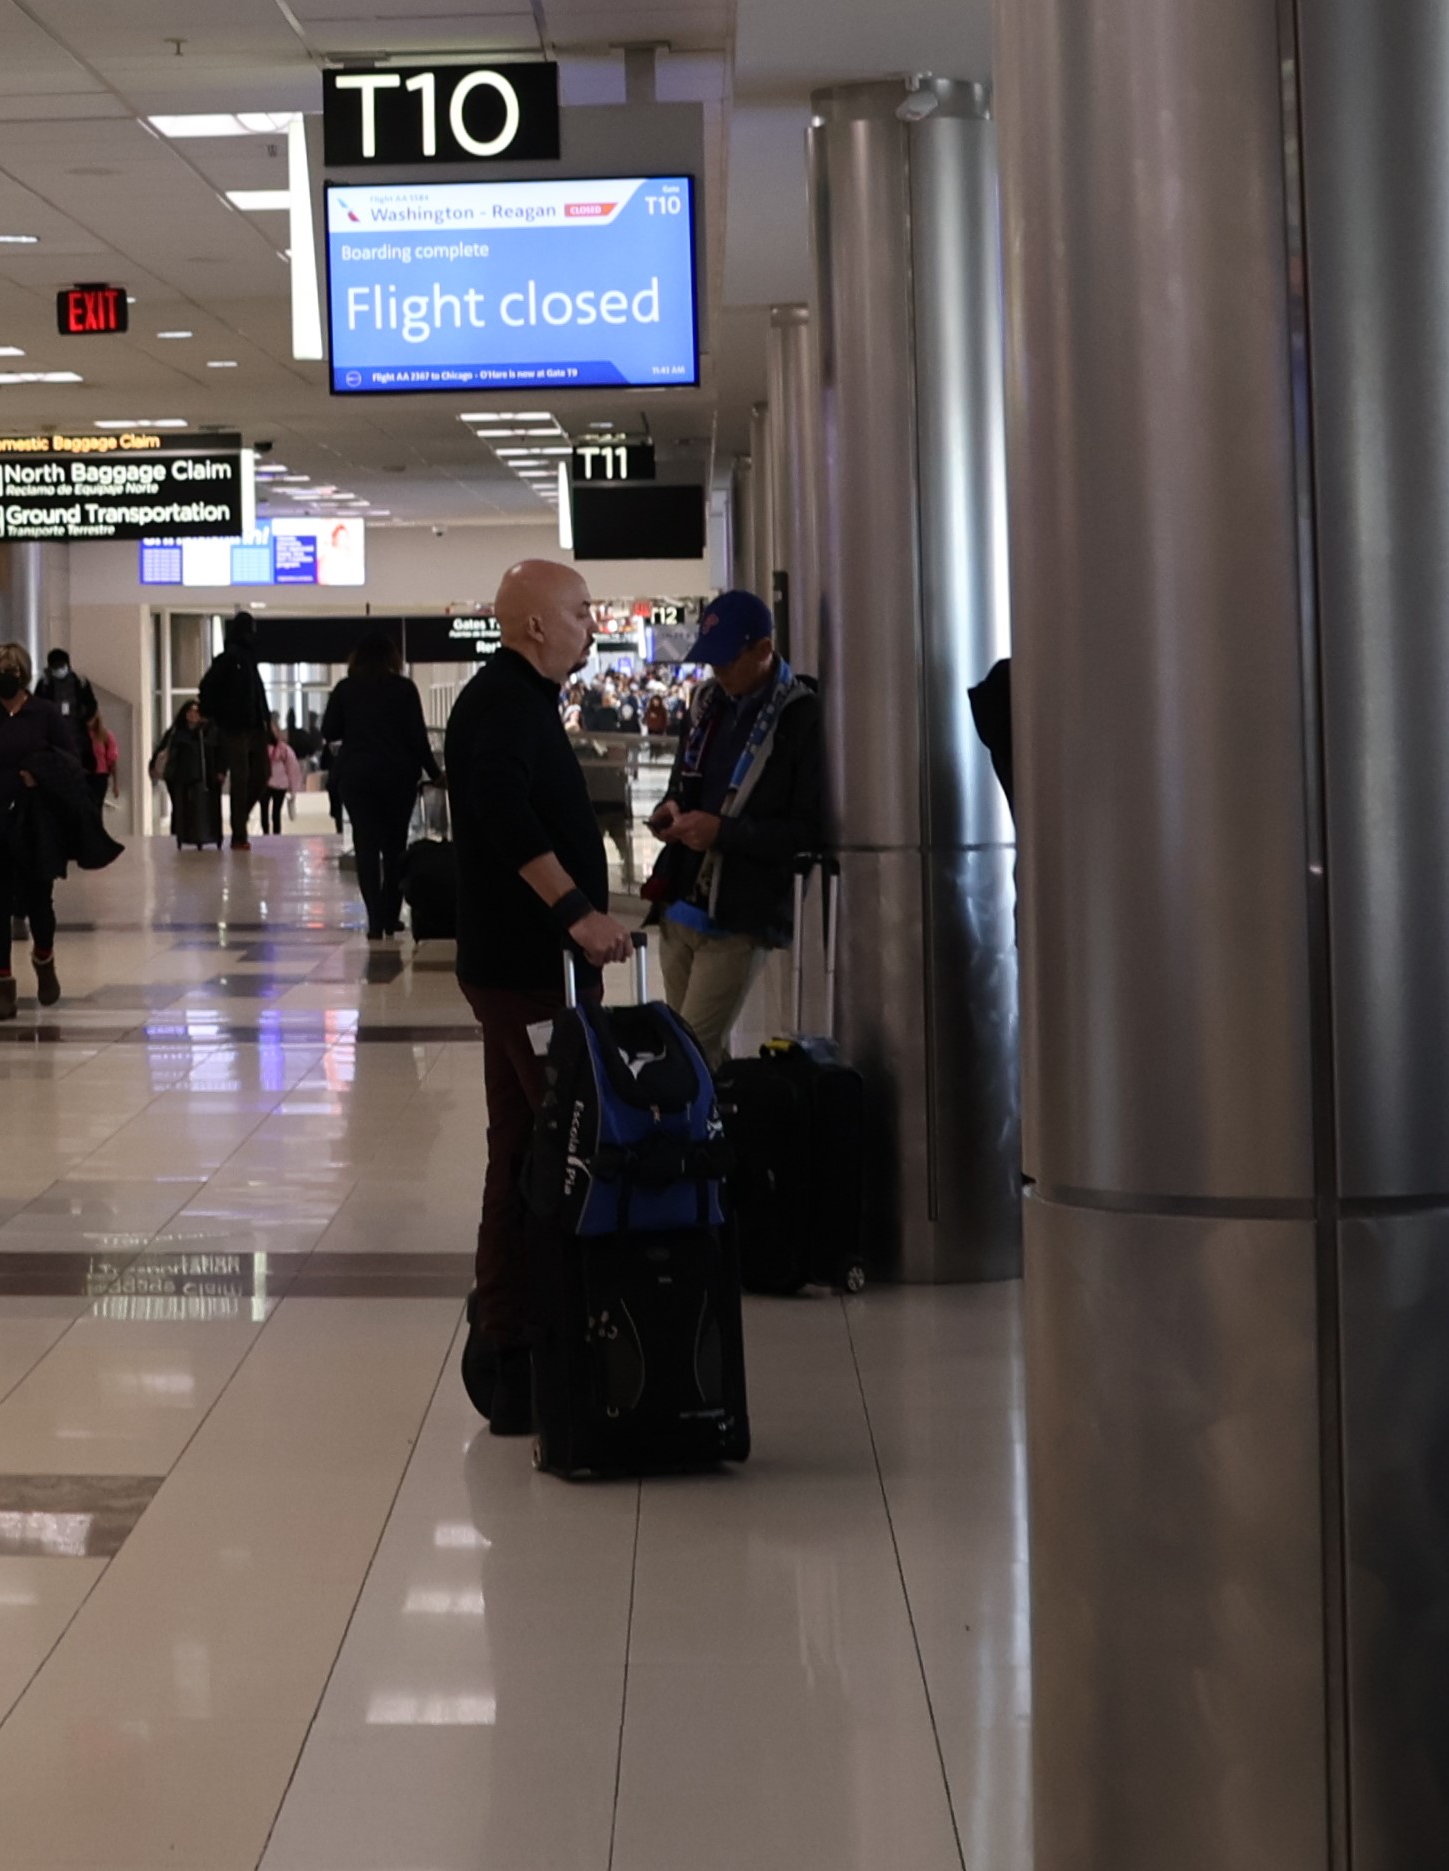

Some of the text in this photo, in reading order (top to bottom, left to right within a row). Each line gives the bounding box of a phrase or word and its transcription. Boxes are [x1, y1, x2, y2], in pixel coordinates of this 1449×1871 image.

[334, 69, 520, 159] T10
[370, 207, 474, 225] Washington
[492, 204, 556, 221] Reagan
[570, 205, 602, 215] CLOSED
[644, 196, 681, 215] T10
[341, 241, 490, 263] Boarding complete
[68, 289, 119, 332] EXIT
[346, 276, 660, 343] Flight closed
[372, 372, 395, 384] Flight
[441, 370, 473, 383] Chicago
[52, 435, 117, 453] Baggage
[119, 433, 161, 449] Claim
[4, 459, 231, 485] North Baggage Claim
[576, 446, 627, 479] T11
[6, 482, 159, 497] Reclamo de Equipaje Norte
[6, 501, 230, 526] Ground Transportation
[7, 523, 115, 537] Transporte Terrestre
